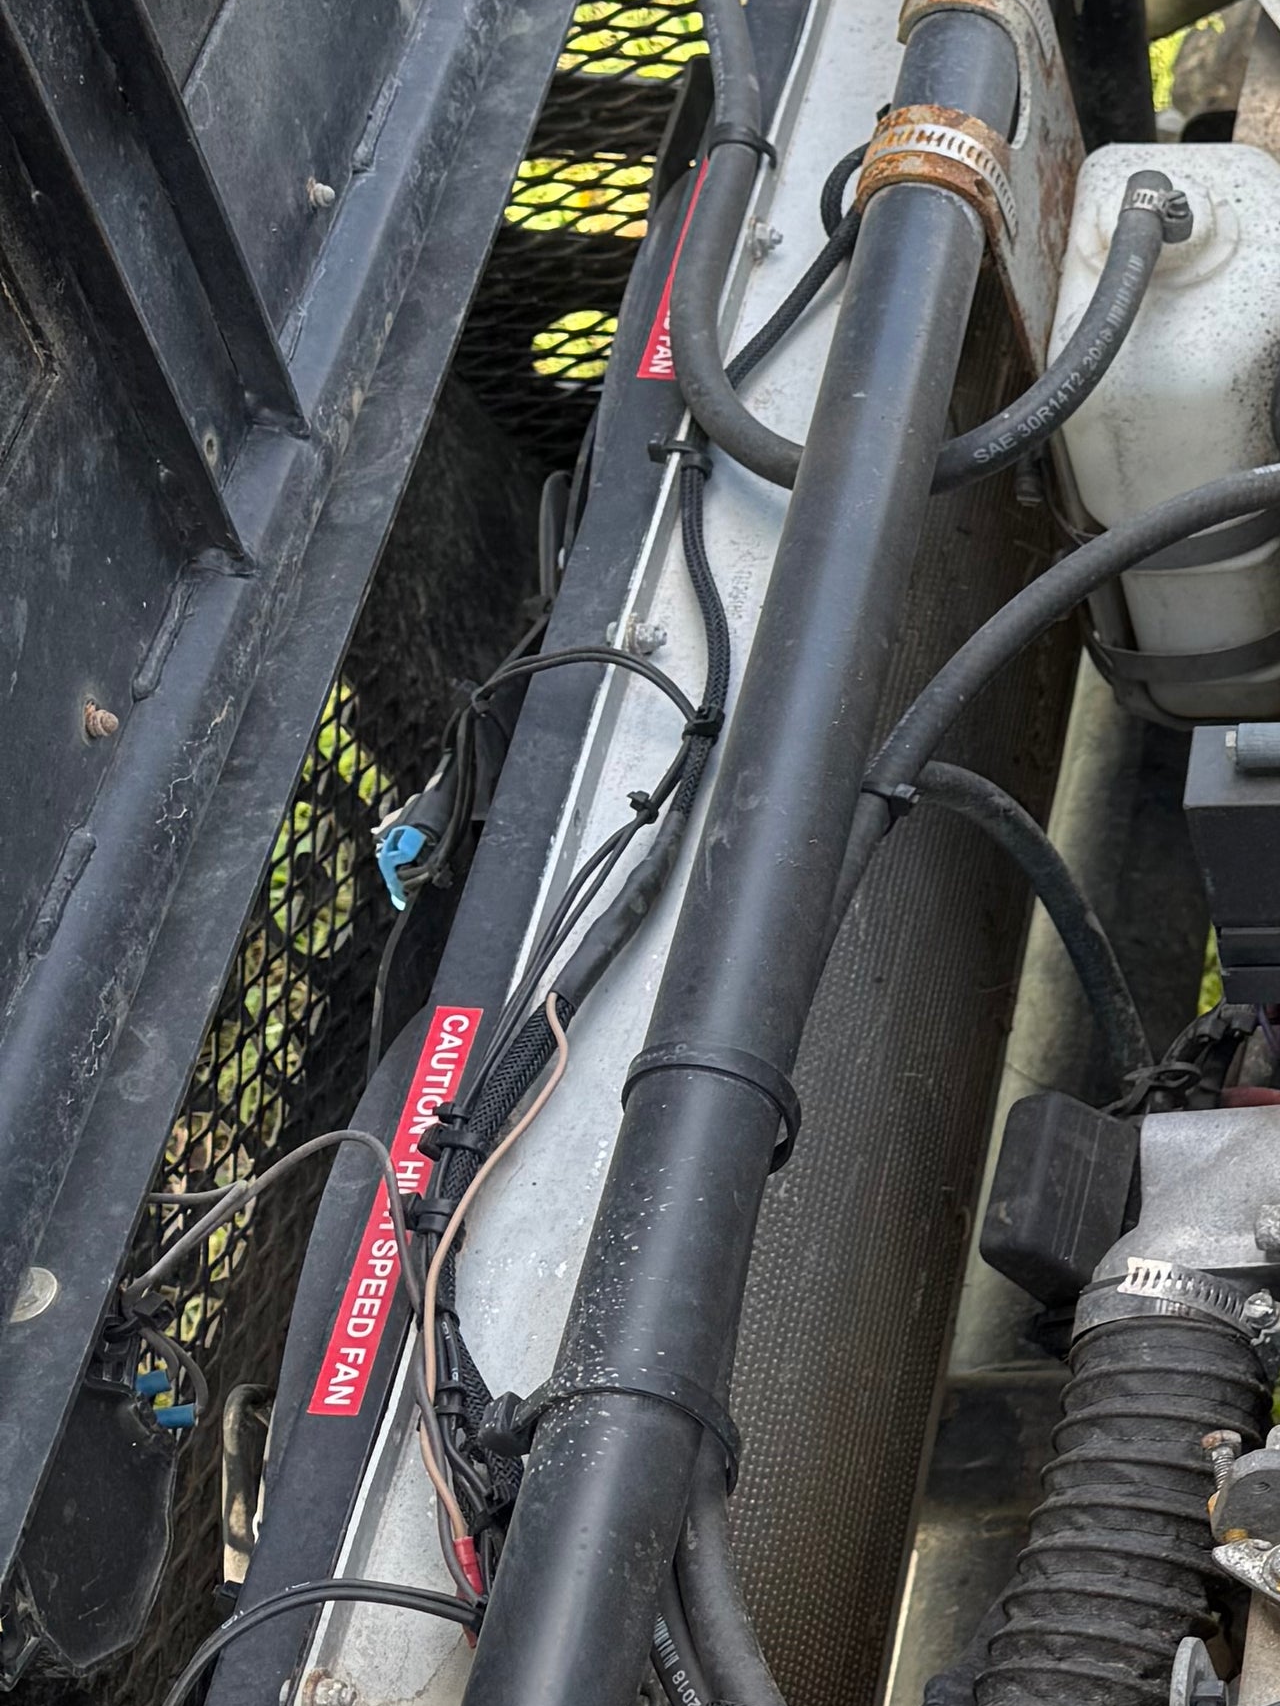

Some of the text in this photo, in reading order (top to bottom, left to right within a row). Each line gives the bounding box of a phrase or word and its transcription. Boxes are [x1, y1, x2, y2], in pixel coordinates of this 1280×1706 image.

[972, 432, 1018, 464] SAE
[1017, 371, 1085, 439] 30R14T2
[406, 1012, 471, 1135] CAUTION
[378, 1160, 424, 1230] HIH
[345, 1238, 399, 1338] SPEED
[323, 1346, 360, 1406] FAN
